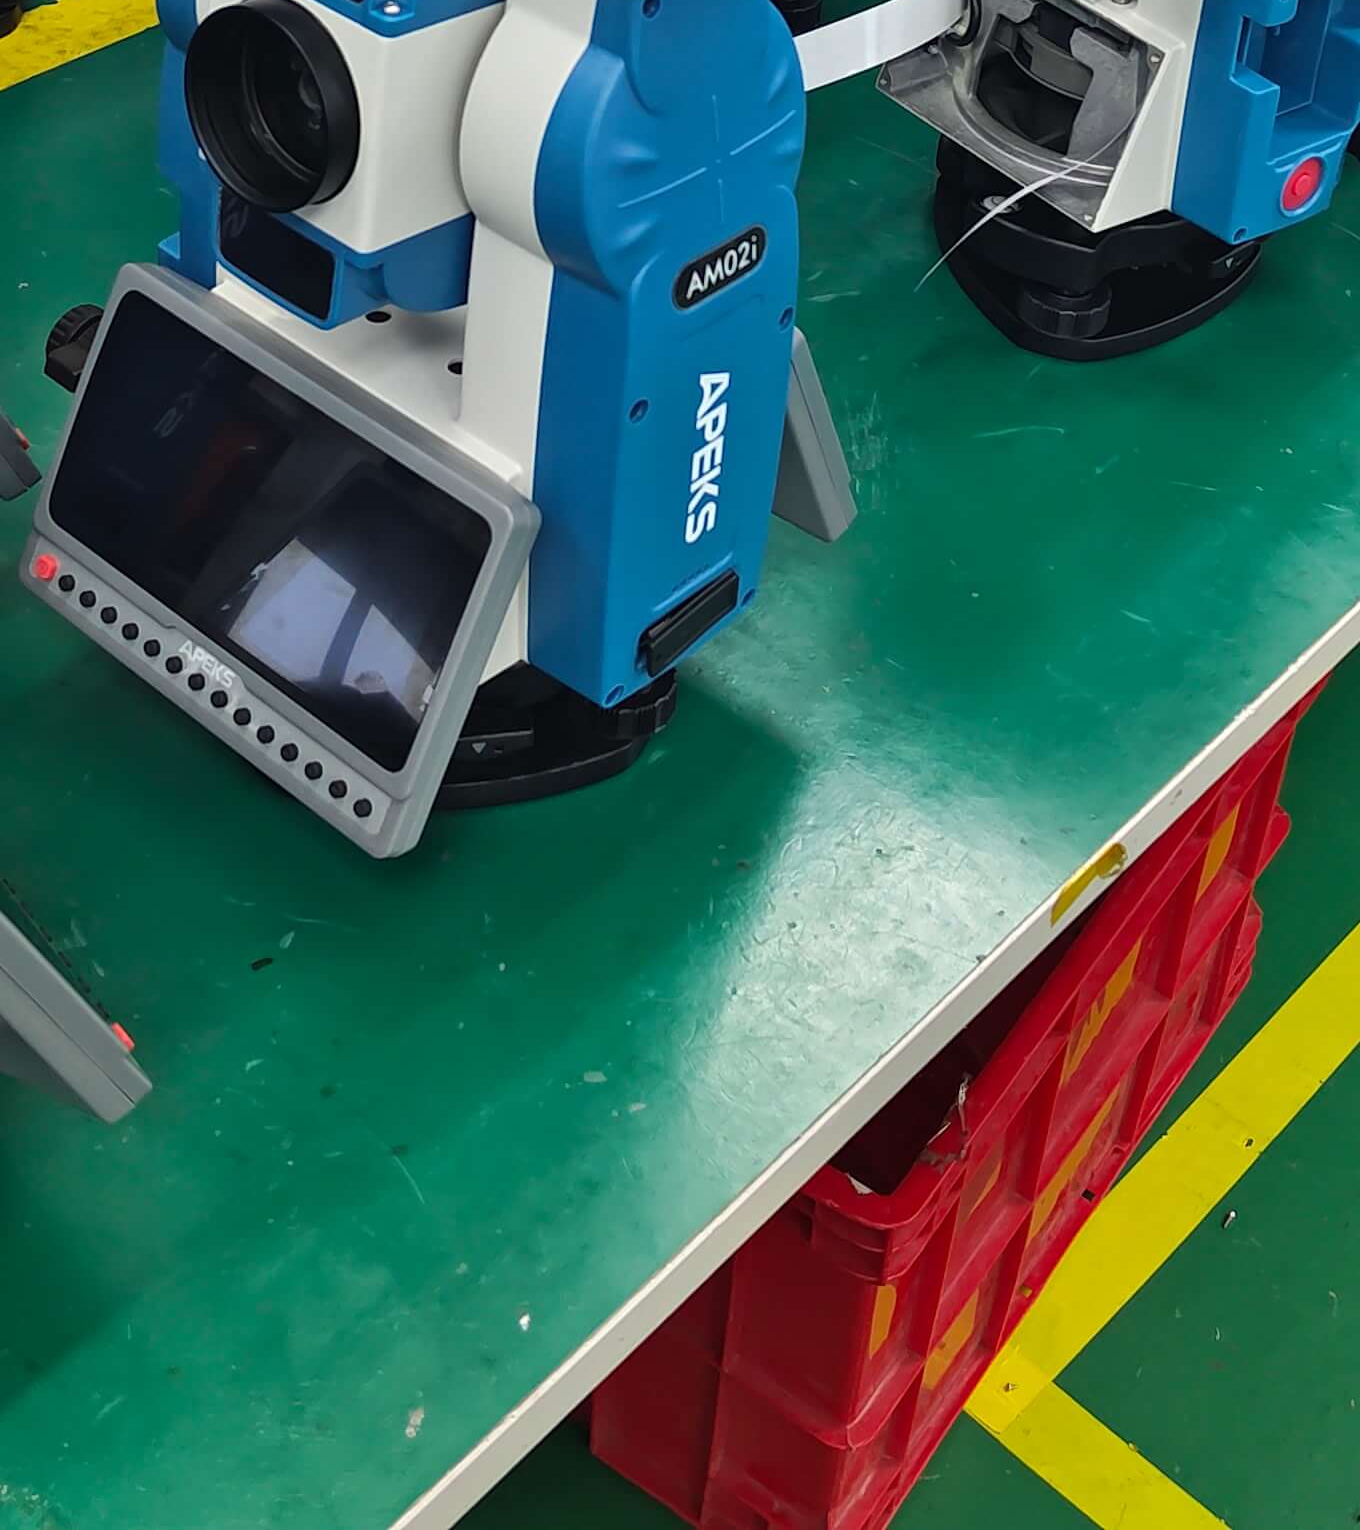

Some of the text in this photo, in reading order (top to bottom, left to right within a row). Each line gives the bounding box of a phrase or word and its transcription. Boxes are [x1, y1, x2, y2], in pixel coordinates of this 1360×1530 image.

[686, 234, 758, 300] AM02i
[685, 372, 731, 544] APEKS
[178, 639, 237, 689] APEKS
